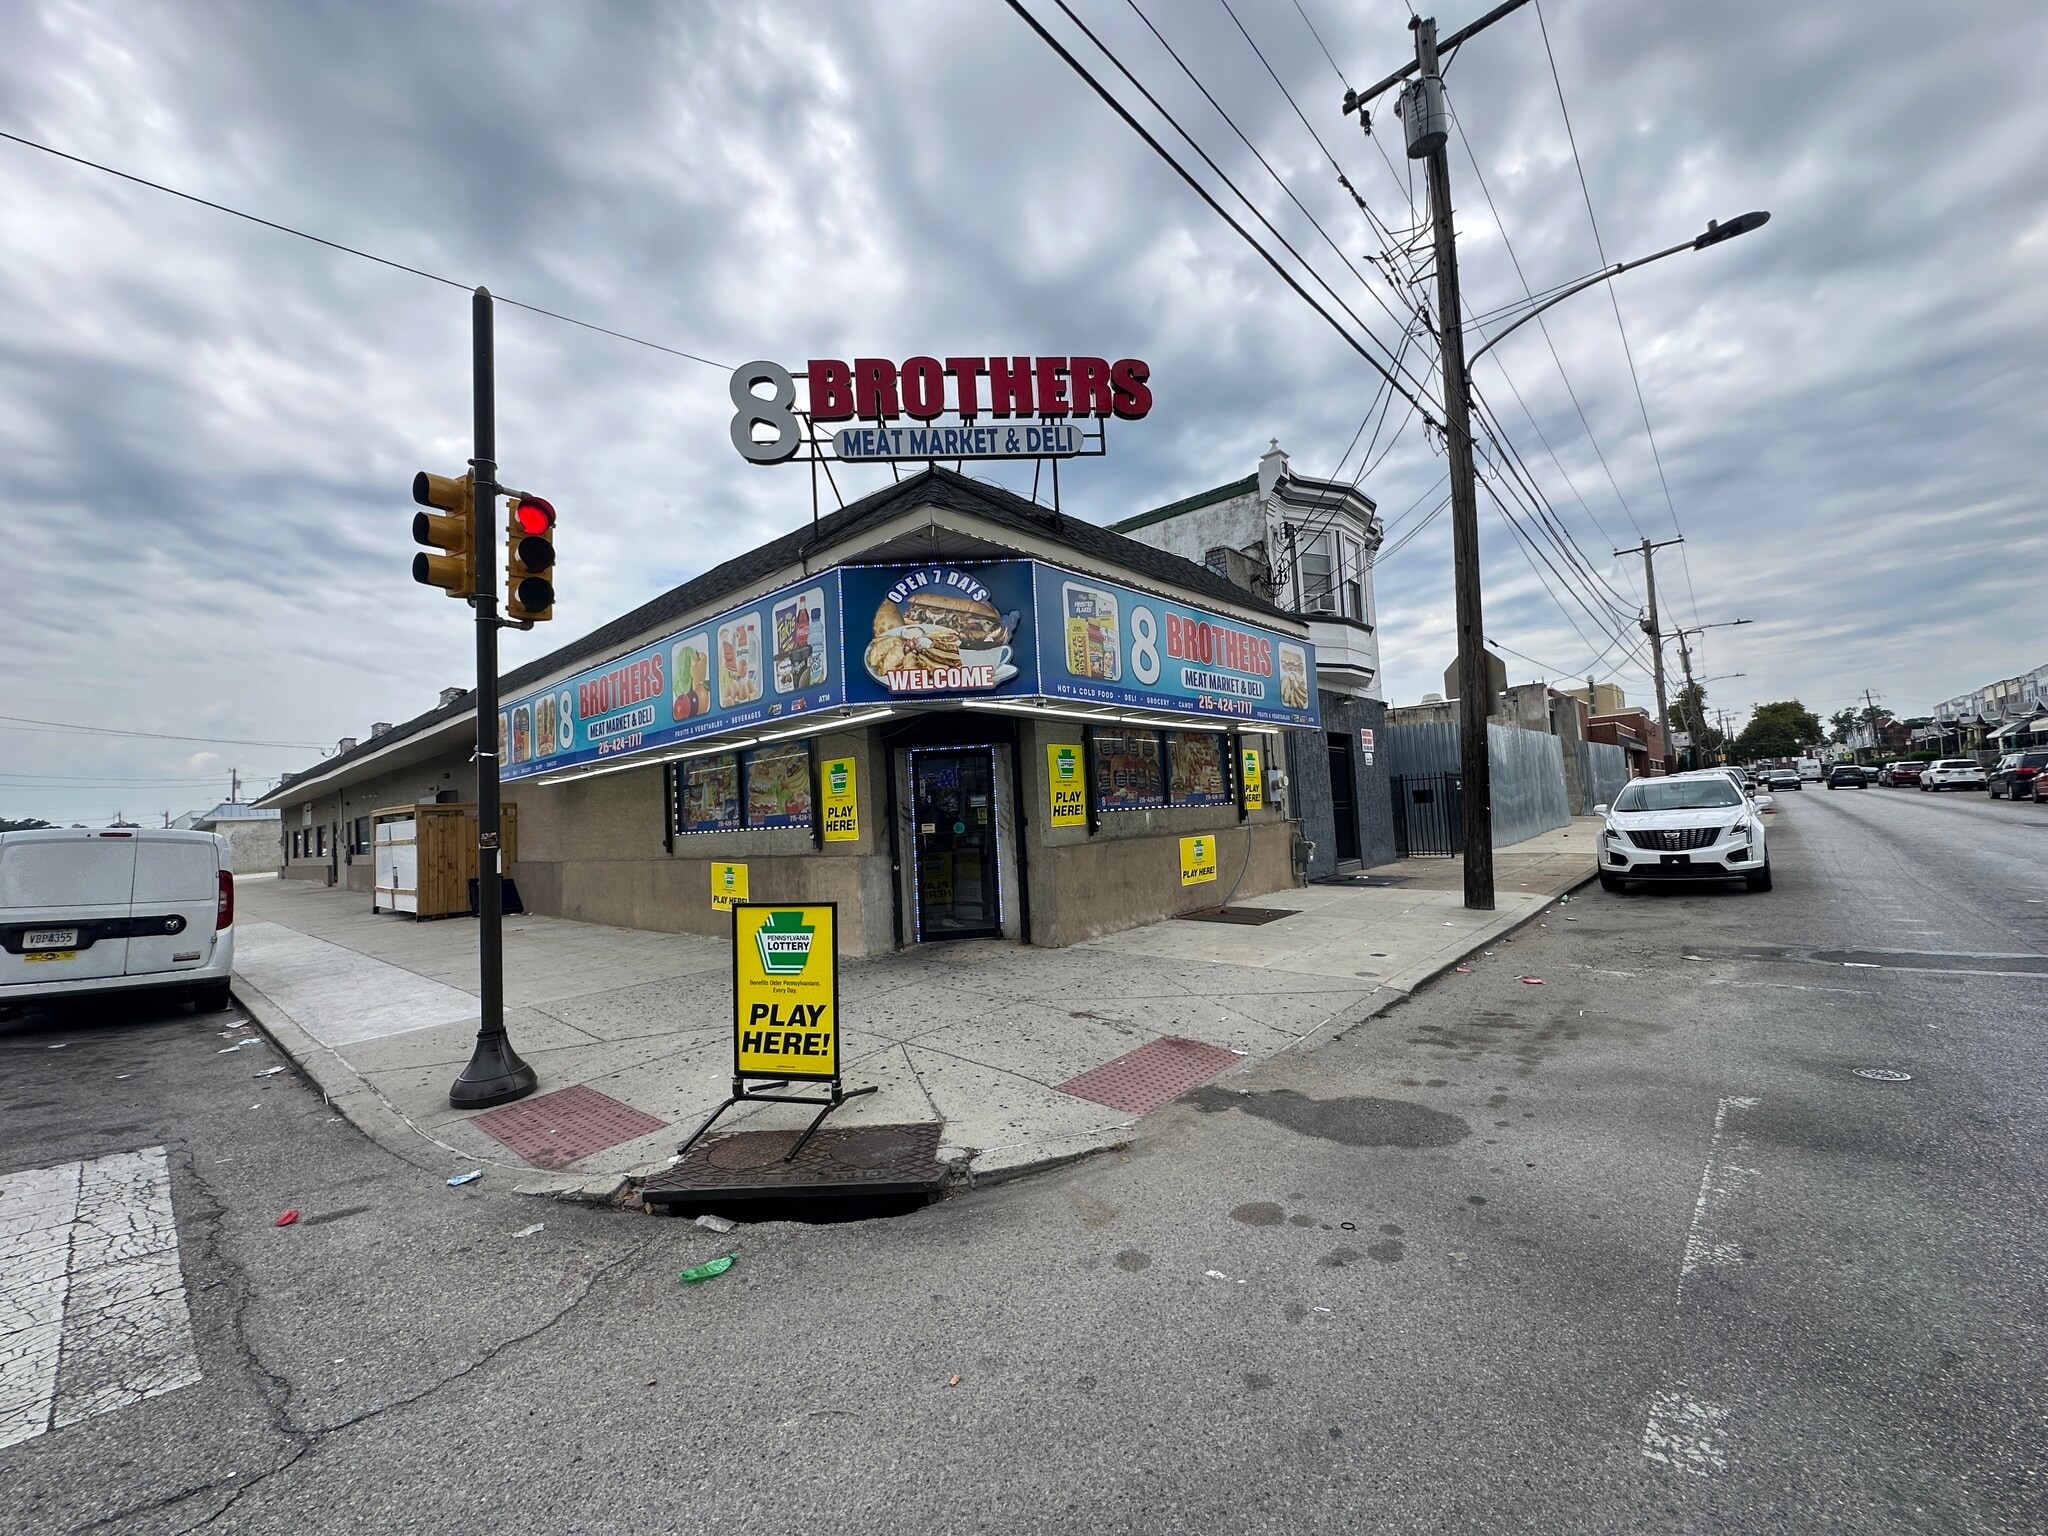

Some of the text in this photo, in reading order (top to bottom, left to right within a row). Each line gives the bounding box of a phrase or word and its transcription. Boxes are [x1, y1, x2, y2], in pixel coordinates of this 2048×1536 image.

[729, 356, 1153, 465] 8 BROTHERS
[843, 426, 1073, 457] MEAT MARKET & DELI
[887, 570, 987, 603] OPEN 7 DAYS
[1130, 604, 1273, 685] 8 BROTHERS
[888, 666, 994, 691] WELCOME
[1185, 669, 1262, 697] MEAT MARKET & DELI
[560, 652, 664, 749] 8 BROTHERS
[1057, 684, 1070, 693] HOT
[1079, 688, 1096, 696] COLD
[1098, 690, 1114, 699] FOOD
[1124, 693, 1137, 702] DELI
[1146, 697, 1170, 706] GROCERY
[1198, 695, 1252, 715] 215-424-1717
[590, 707, 652, 739] MEAT MARKET & DELI
[695, 720, 723, 732] VEGETABLES
[731, 711, 762, 724] BEVERAGES
[598, 732, 642, 755] 215-424-1717
[1055, 791, 1081, 803] PLAY
[1245, 784, 1259, 793] PLAY
[828, 805, 854, 818] PLAY
[1053, 804, 1084, 817] HERE!
[826, 819, 856, 832] HERE!
[1183, 868, 1199, 879] PLAY
[1199, 866, 1215, 876] HERE!
[713, 895, 729, 904] PLAY
[767, 941, 810, 951] LOTTERY
[749, 1003, 827, 1028] PLAY
[741, 1031, 831, 1056] HERE!
